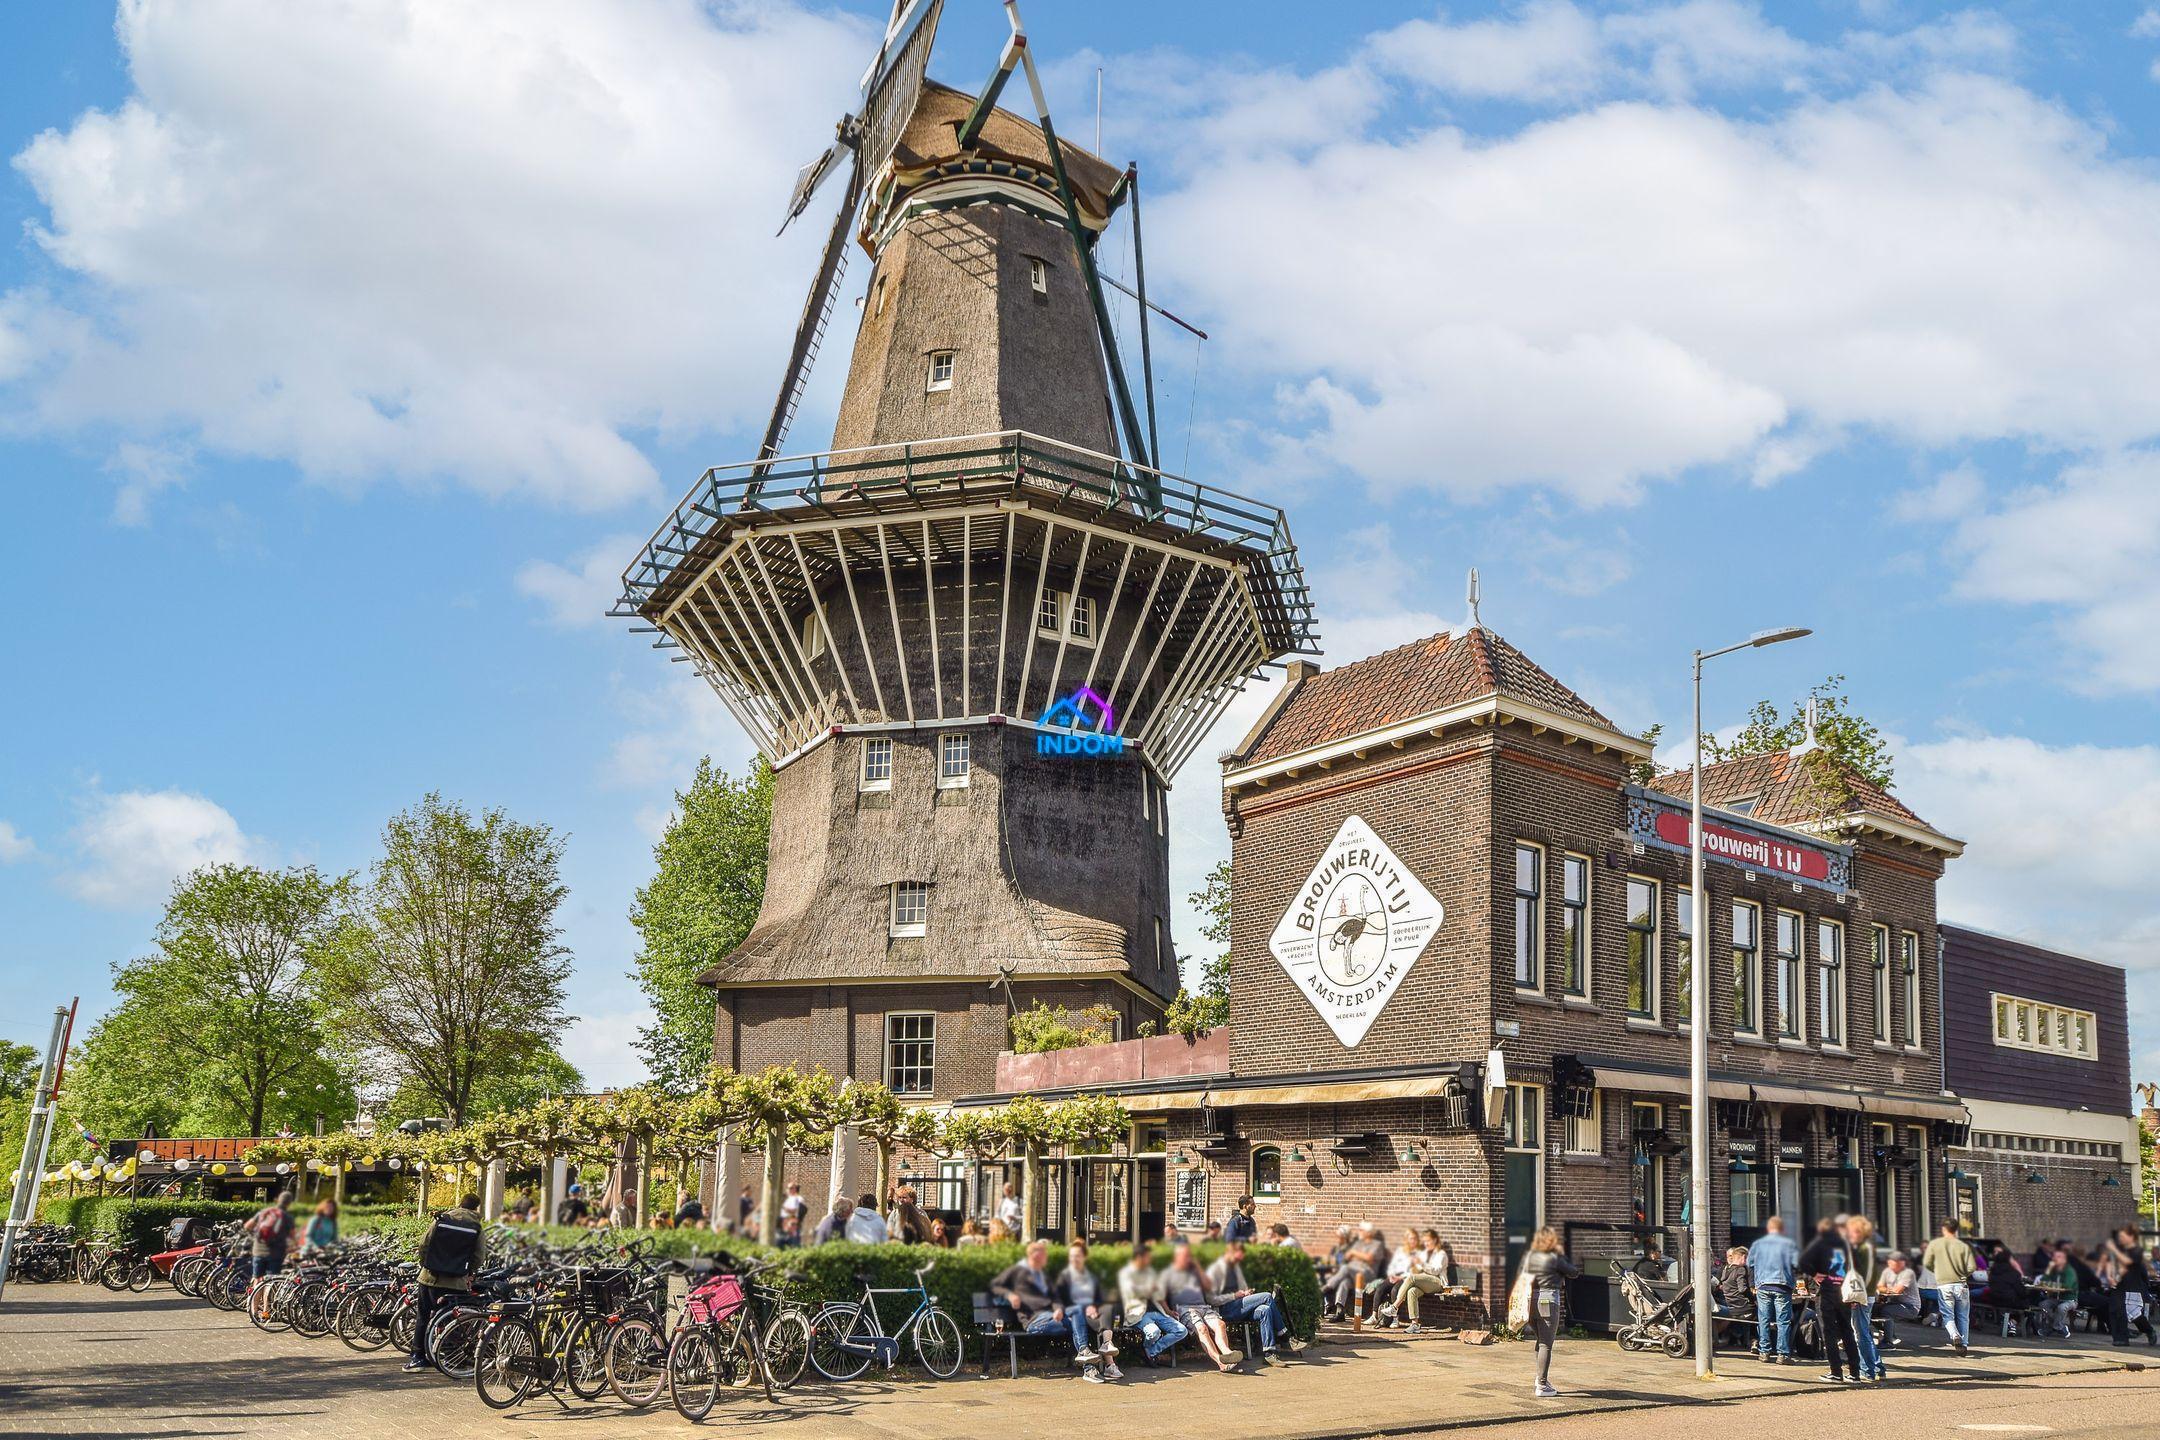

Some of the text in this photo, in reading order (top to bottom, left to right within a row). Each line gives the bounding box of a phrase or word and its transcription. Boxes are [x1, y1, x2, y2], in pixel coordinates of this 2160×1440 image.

[1689, 823, 1768, 867] rouwerij
[1786, 850, 1802, 873] IJ
[1296, 848, 1388, 932] BROUWERIJ
[1308, 963, 1398, 1007] AMSTERDAM
[1729, 1142, 1756, 1152] VROUWEN
[1781, 1146, 1803, 1154] MANNEN
